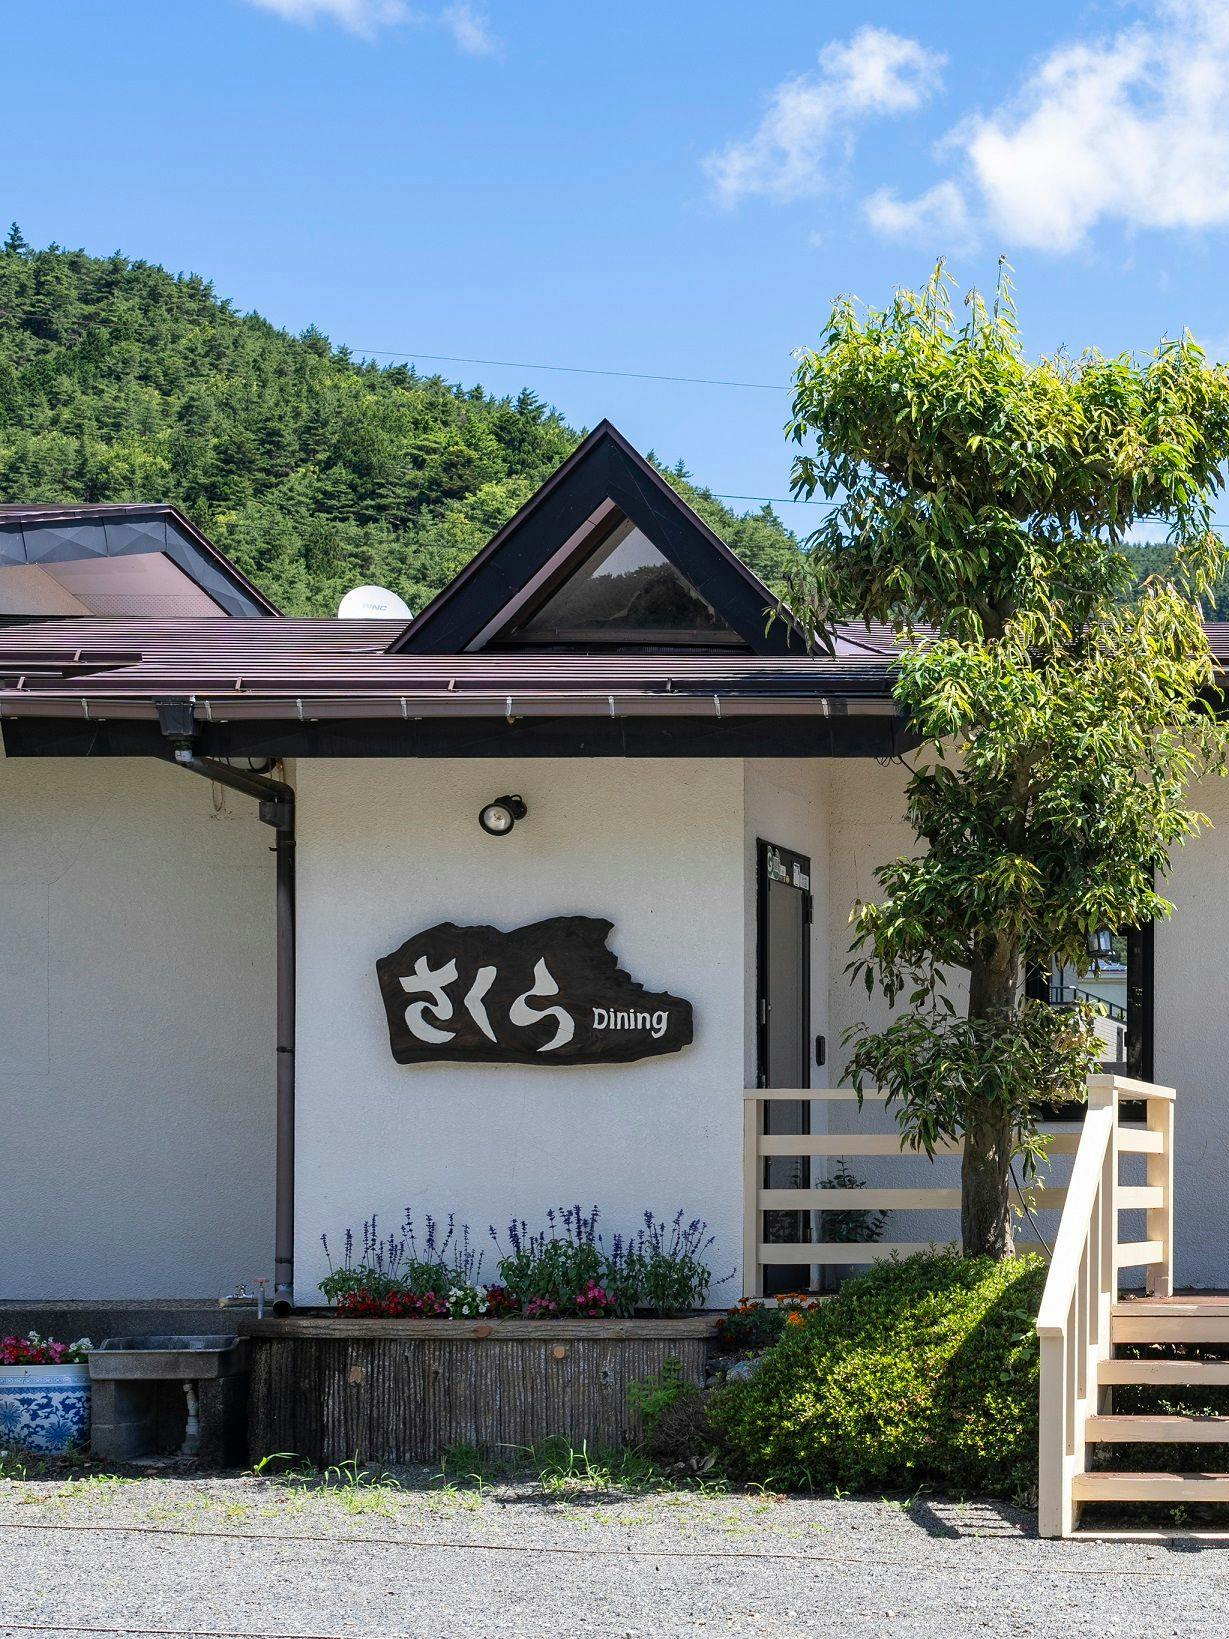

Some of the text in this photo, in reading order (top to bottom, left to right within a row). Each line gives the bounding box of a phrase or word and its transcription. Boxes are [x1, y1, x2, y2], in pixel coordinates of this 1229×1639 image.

[399, 955, 669, 1051] さくら Dining
